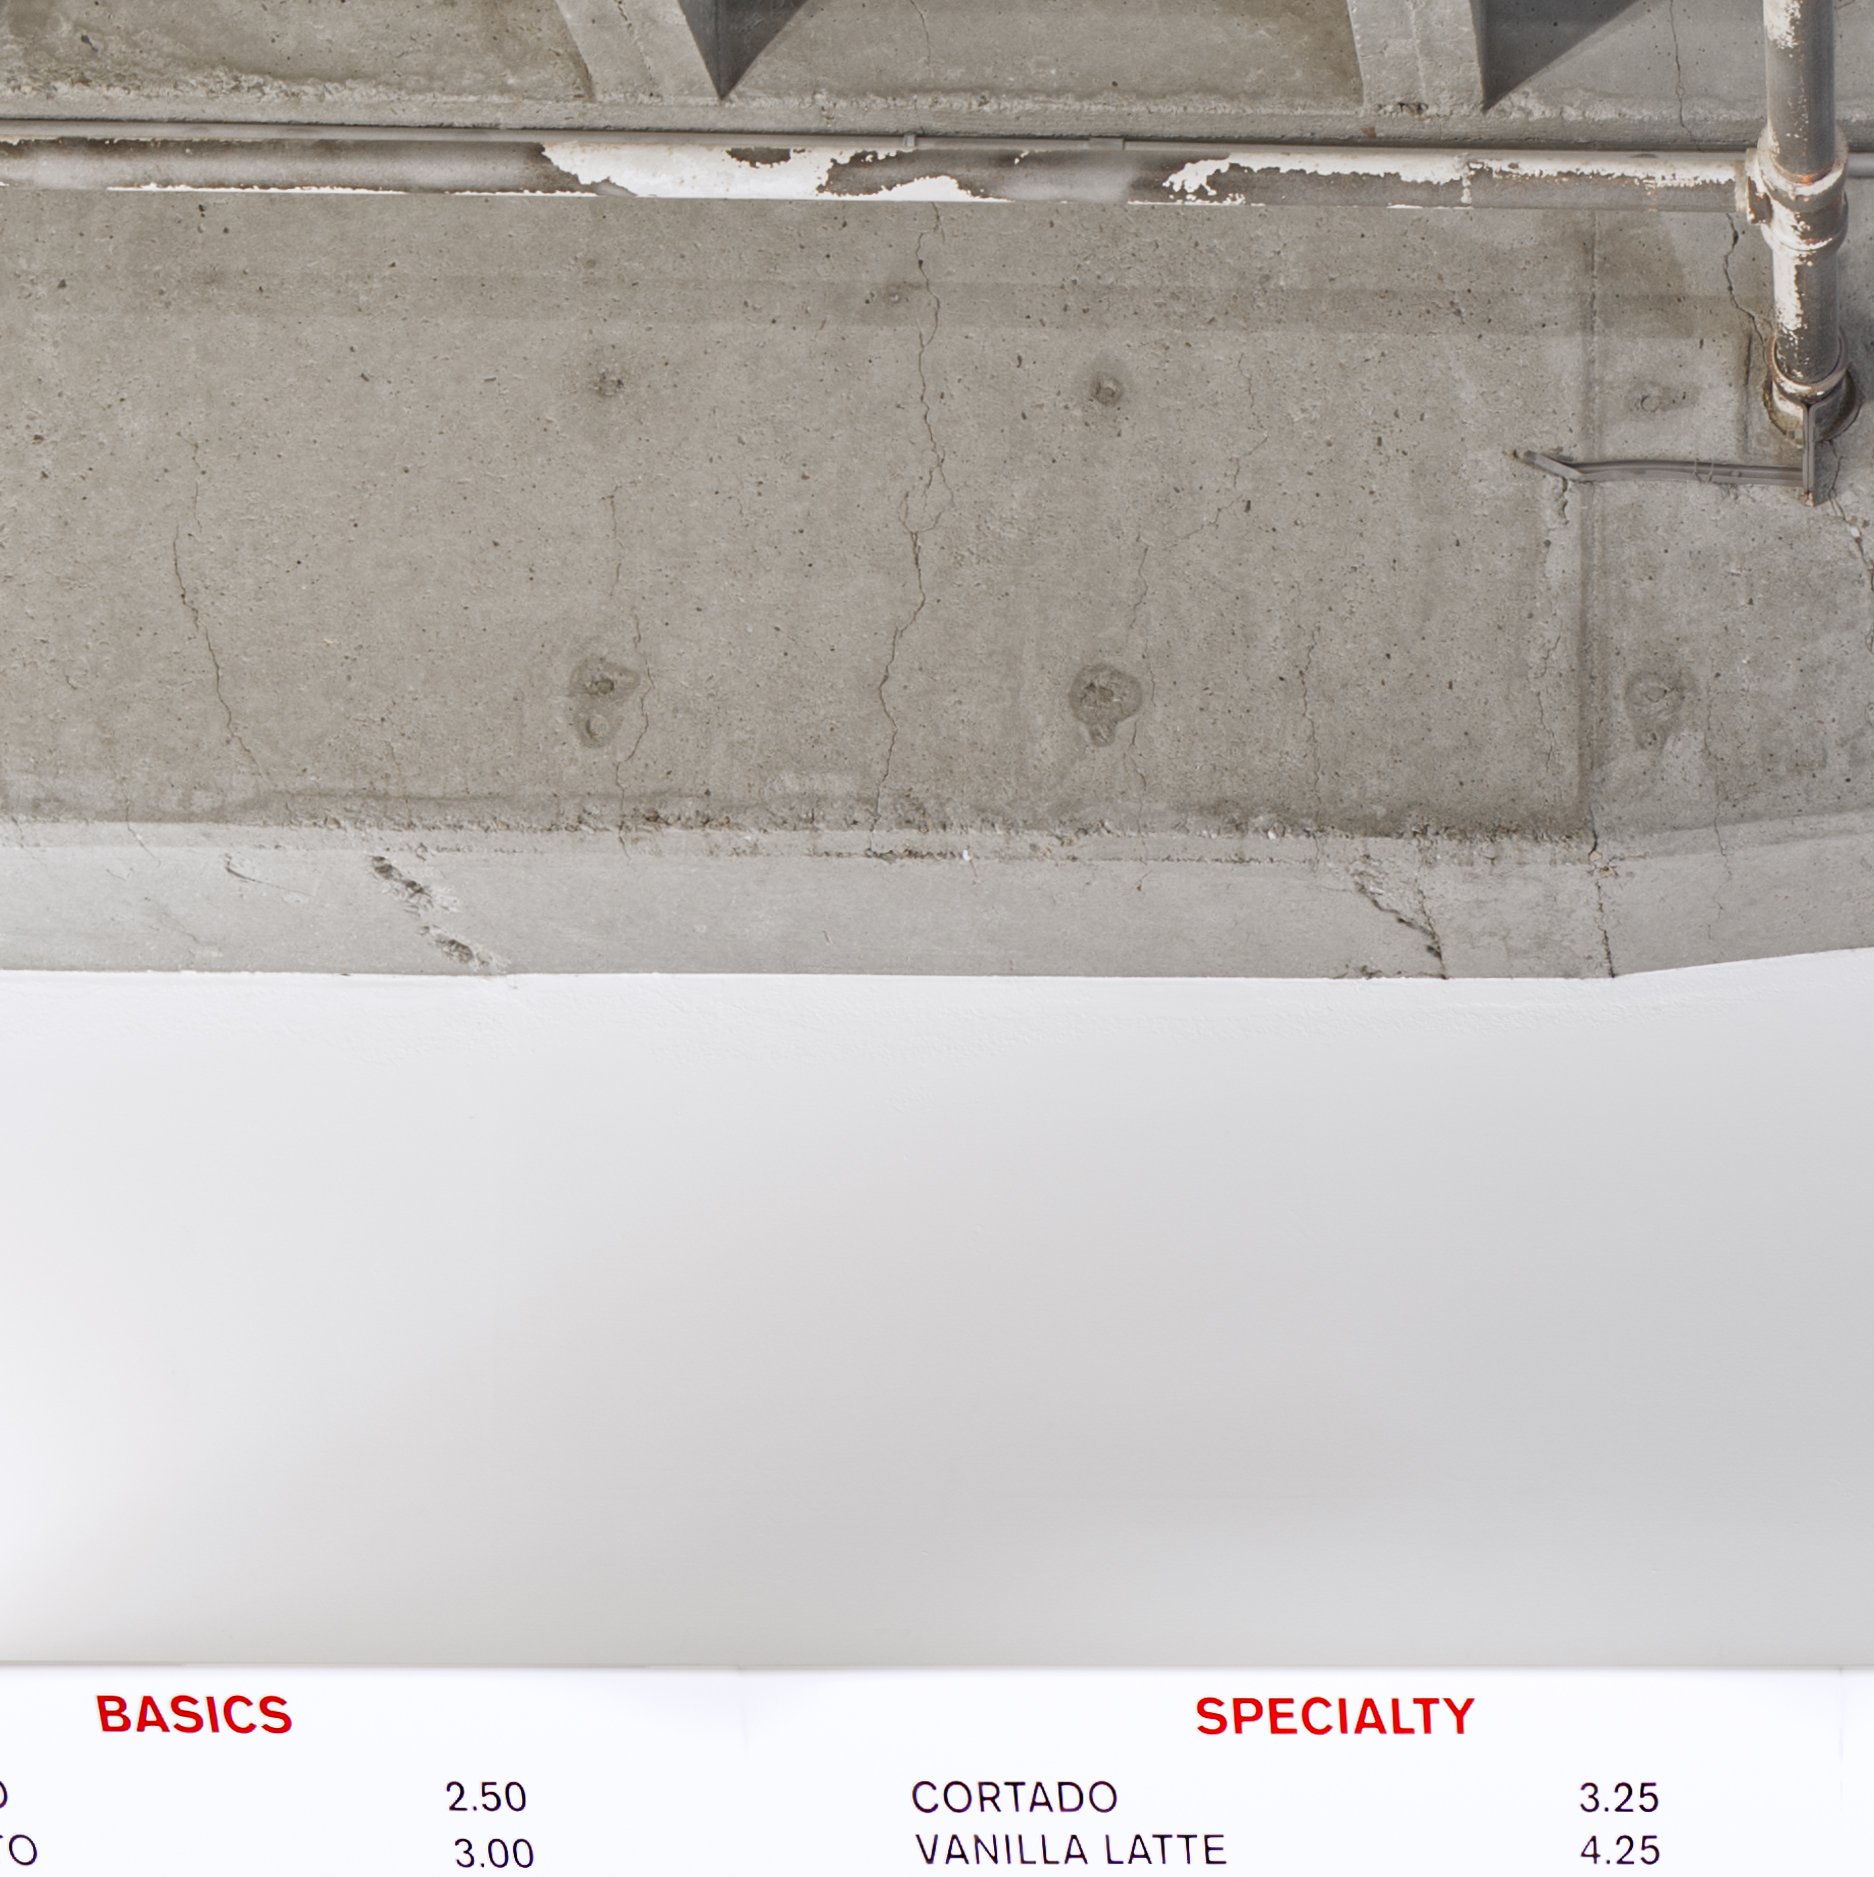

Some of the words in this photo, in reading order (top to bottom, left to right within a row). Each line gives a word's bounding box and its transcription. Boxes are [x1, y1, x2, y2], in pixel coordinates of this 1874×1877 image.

[96, 1695, 292, 1734] BASICS
[1196, 1696, 1475, 1735] SPECIALTY
[446, 1781, 526, 1812] 2.50
[912, 1780, 1117, 1813] CORTADO
[1580, 1782, 1659, 1813] 3.25
[455, 1838, 534, 1868] 3.00
[915, 1834, 1088, 1865] VANILLA
[1105, 1834, 1227, 1865] LATTE
[1580, 1835, 1660, 1865] 4.25
